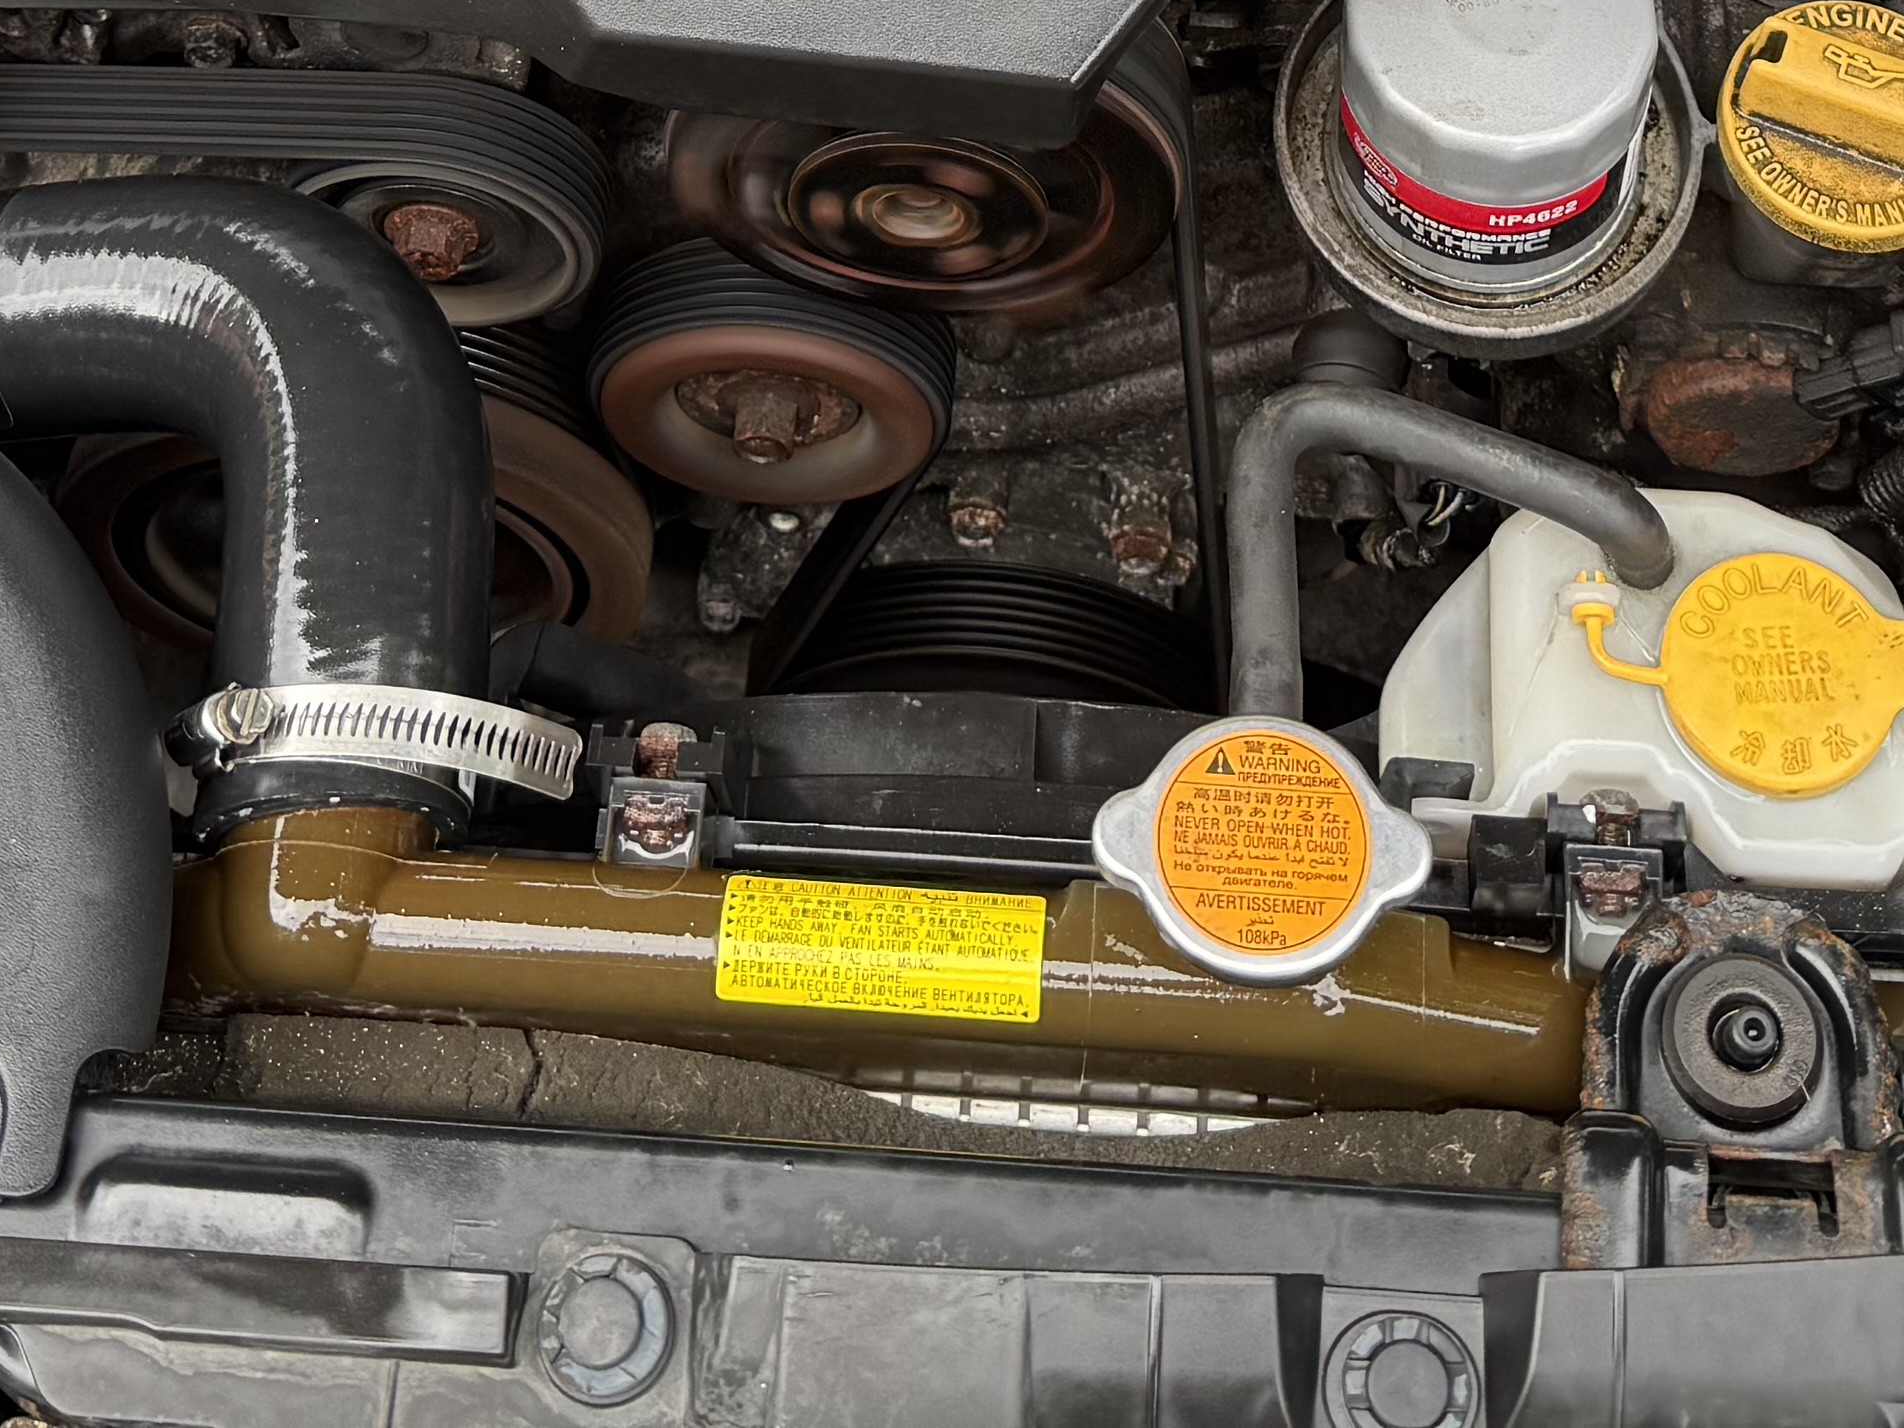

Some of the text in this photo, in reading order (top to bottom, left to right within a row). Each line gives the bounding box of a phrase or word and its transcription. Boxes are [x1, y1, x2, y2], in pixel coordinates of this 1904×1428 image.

[1736, 125, 1772, 164] SEE
[1760, 162, 1849, 224] OWNER'S
[1364, 182, 1550, 256] SYNTHETIC
[1399, 200, 1551, 242] PERFORMANCE
[1488, 200, 1578, 228] HP4622
[1412, 233, 1482, 261] OIL FILTER
[1680, 563, 1869, 638] COOLANT
[1742, 625, 1796, 650] SEE
[1731, 651, 1832, 677] OWNERS
[1734, 677, 1836, 706] MANUAL
[1244, 740, 1291, 755] 警告
[1730, 724, 1859, 776] 冷却水
[1239, 755, 1321, 774] WARNING
[1238, 772, 1340, 789] ПРЕДУПРЕЖДЕНИЕ
[1193, 787, 1334, 810] 高温时请勿打开
[1174, 815, 1351, 841] NEVER OPEN WHEN HOT.
[1174, 831, 1351, 855] NE JAMAIS OUVRIR CHAUD.
[1174, 860, 1348, 882] Не открывать на горячем
[1222, 876, 1297, 890] двигателе.
[791, 882, 912, 901] CAUTION ATTENTION
[966, 894, 1032, 909] ВНИМАНИЕ
[1196, 893, 1326, 916] AVERTISSEMENT
[736, 916, 764, 928] KEEP
[770, 918, 805, 932] HANDS
[850, 924, 872, 936] FAN
[877, 926, 919, 940] STARTS
[1237, 929, 1287, 946] 108kPa
[819, 934, 834, 947] DU
[839, 936, 911, 953] VENTILATEUR
[768, 946, 833, 964] APPROCHEZ
[841, 951, 862, 964] PAS
[869, 952, 891, 967] LES
[732, 960, 790, 977] ДЕРЖИТЕ
[795, 962, 827, 978] РУКИ
[833, 967, 841, 979] В
[731, 974, 848, 994] АВТОМАТИЧЕСКОЕ
[853, 983, 928, 1000] ВКЛЮЧЕНИЕ
[932, 987, 1029, 1009] ВЕНТИЛЯТОРА.
